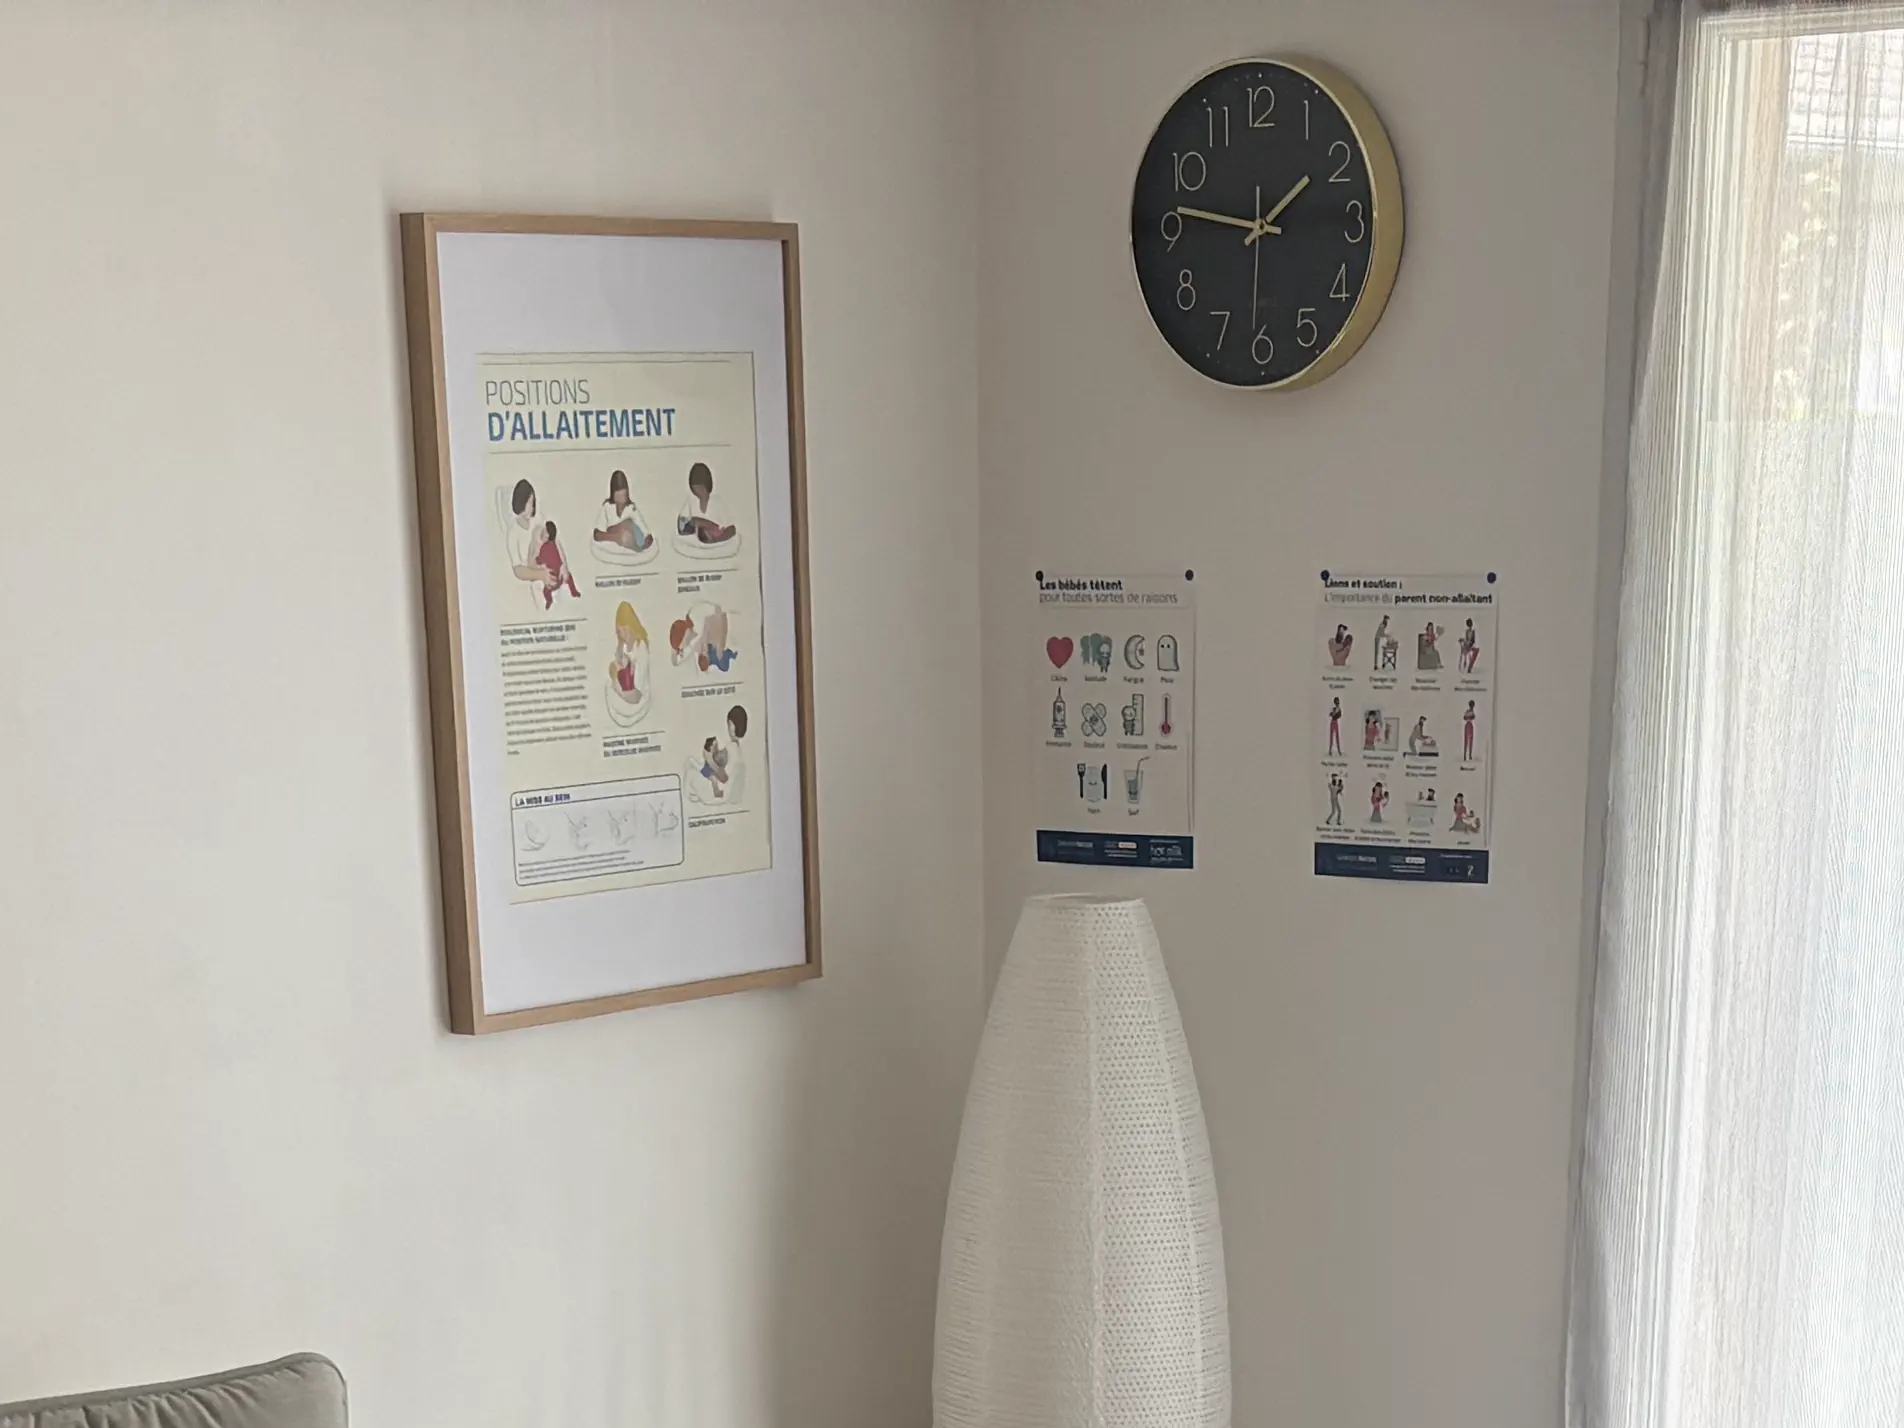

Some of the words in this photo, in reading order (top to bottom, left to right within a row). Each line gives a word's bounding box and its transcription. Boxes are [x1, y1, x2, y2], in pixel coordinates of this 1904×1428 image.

[1207, 105, 1230, 148] 11
[1247, 86, 1276, 128] 12
[1303, 99, 1310, 141] 1
[1172, 151, 1207, 192] 10
[1328, 140, 1351, 183] 2
[1160, 211, 1183, 252] 9
[1344, 200, 1364, 244] 3
[1176, 269, 1196, 311] 8
[1329, 263, 1350, 303] 4
[1210, 311, 1232, 351] 7
[1251, 324, 1273, 364] 6
[1296, 308, 1318, 347] 5
[485, 378, 591, 406] POSITIONS
[487, 407, 676, 442] D'ALLAITEMENT
[1039, 579, 1056, 590] Les
[1095, 592, 1124, 603] sortes
[1127, 592, 1140, 603] de
[1141, 593, 1178, 604] raisons
[1351, 579, 1360, 589] et
[1395, 593, 1427, 605] parent
